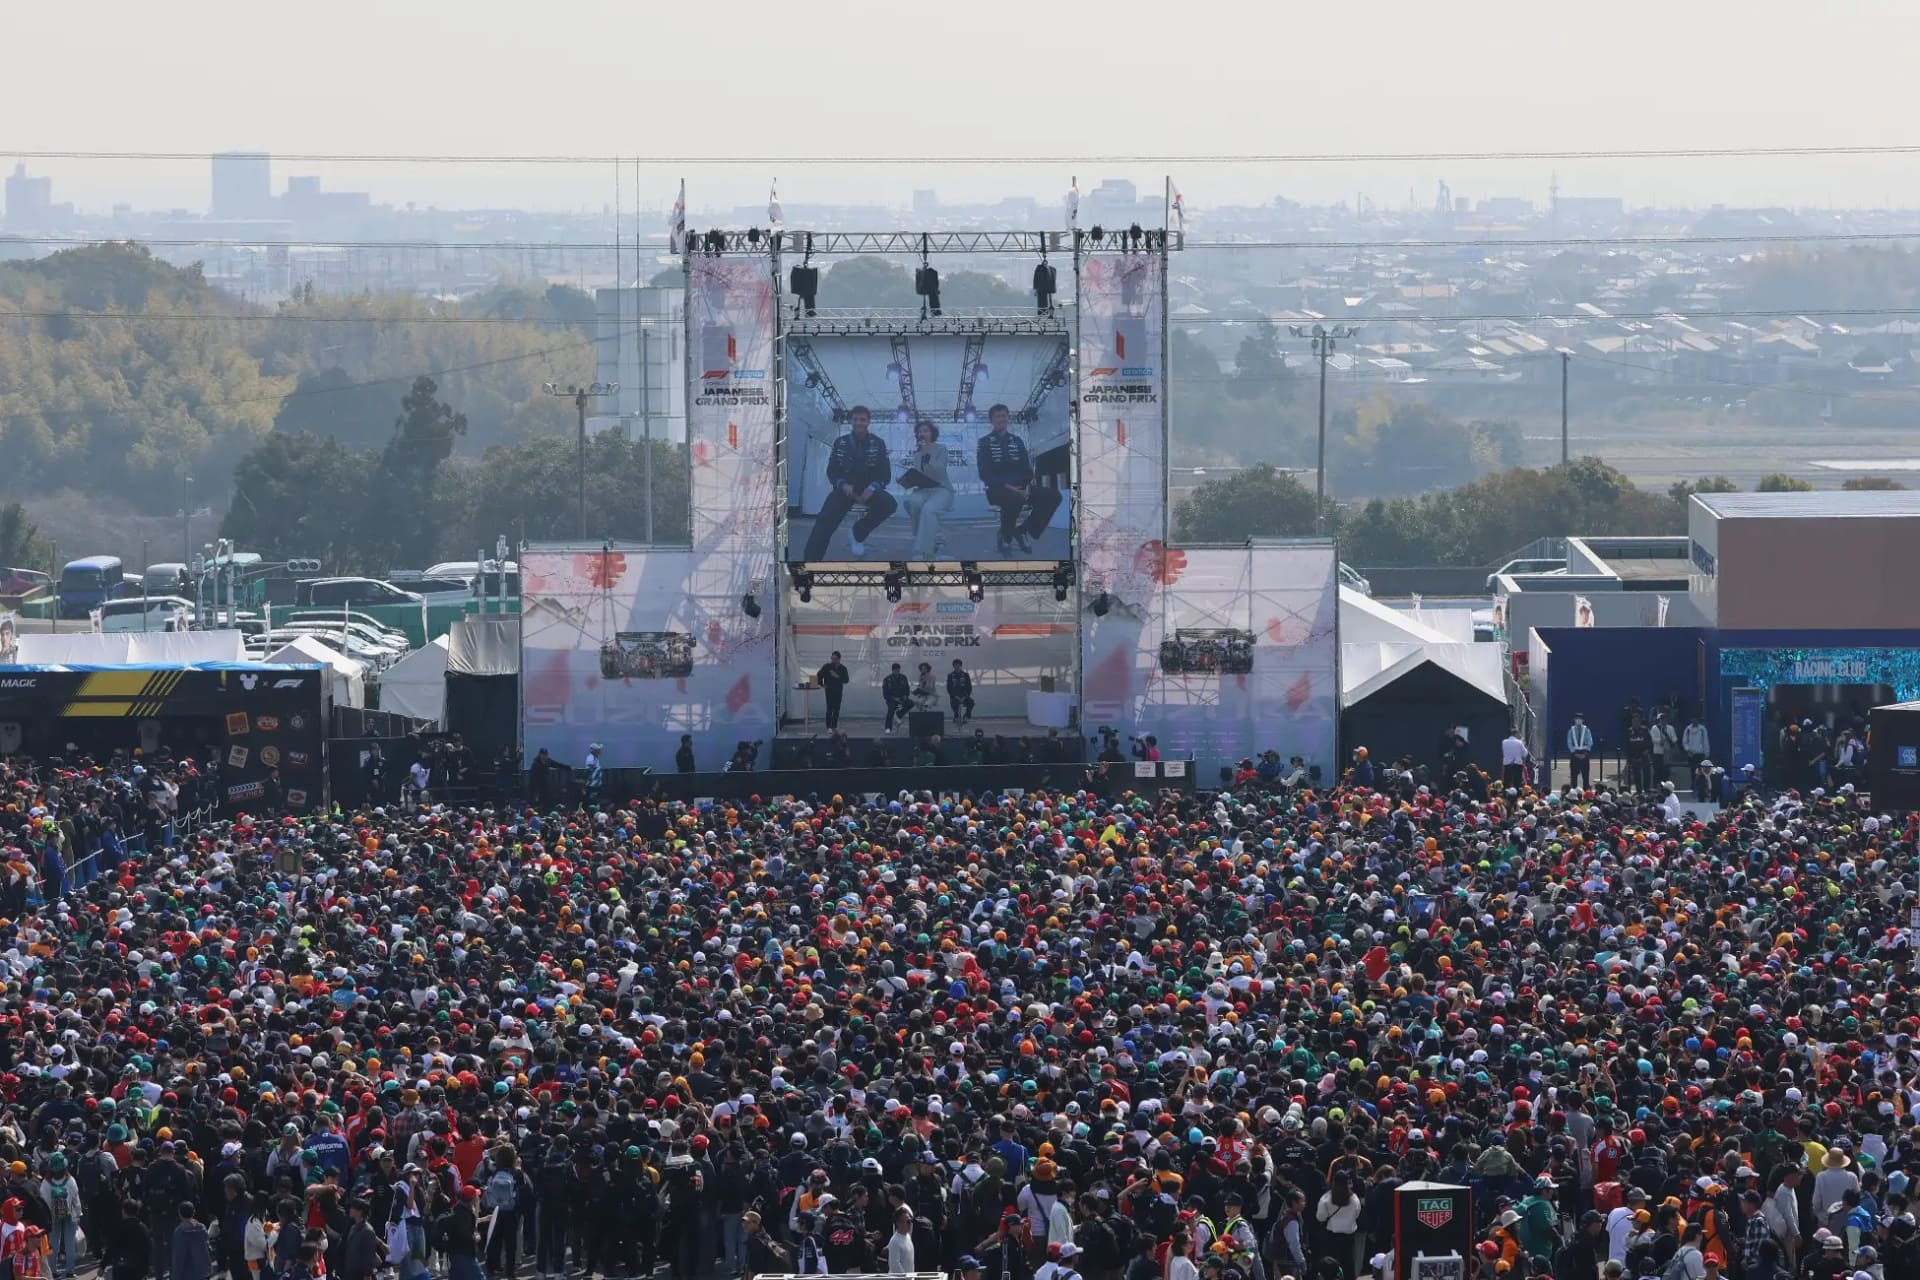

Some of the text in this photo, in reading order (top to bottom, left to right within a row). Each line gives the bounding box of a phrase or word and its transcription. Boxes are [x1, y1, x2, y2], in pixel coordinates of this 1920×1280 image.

[702, 388, 764, 396] JAPANESE
[1089, 385, 1152, 393] JAPANESE
[695, 397, 769, 406] GRAND PRIX
[1083, 395, 1157, 403] GRAND PRIX
[894, 625, 973, 635] JAPANESE
[887, 637, 980, 647] GRAND PRIX
[1795, 661, 1866, 677] RACING CLUB
[1, 679, 37, 688] MAGIC
[1421, 1200, 1449, 1210] TAG
[1420, 1211, 1450, 1227] HEUER
[831, 1230, 854, 1245] 44
